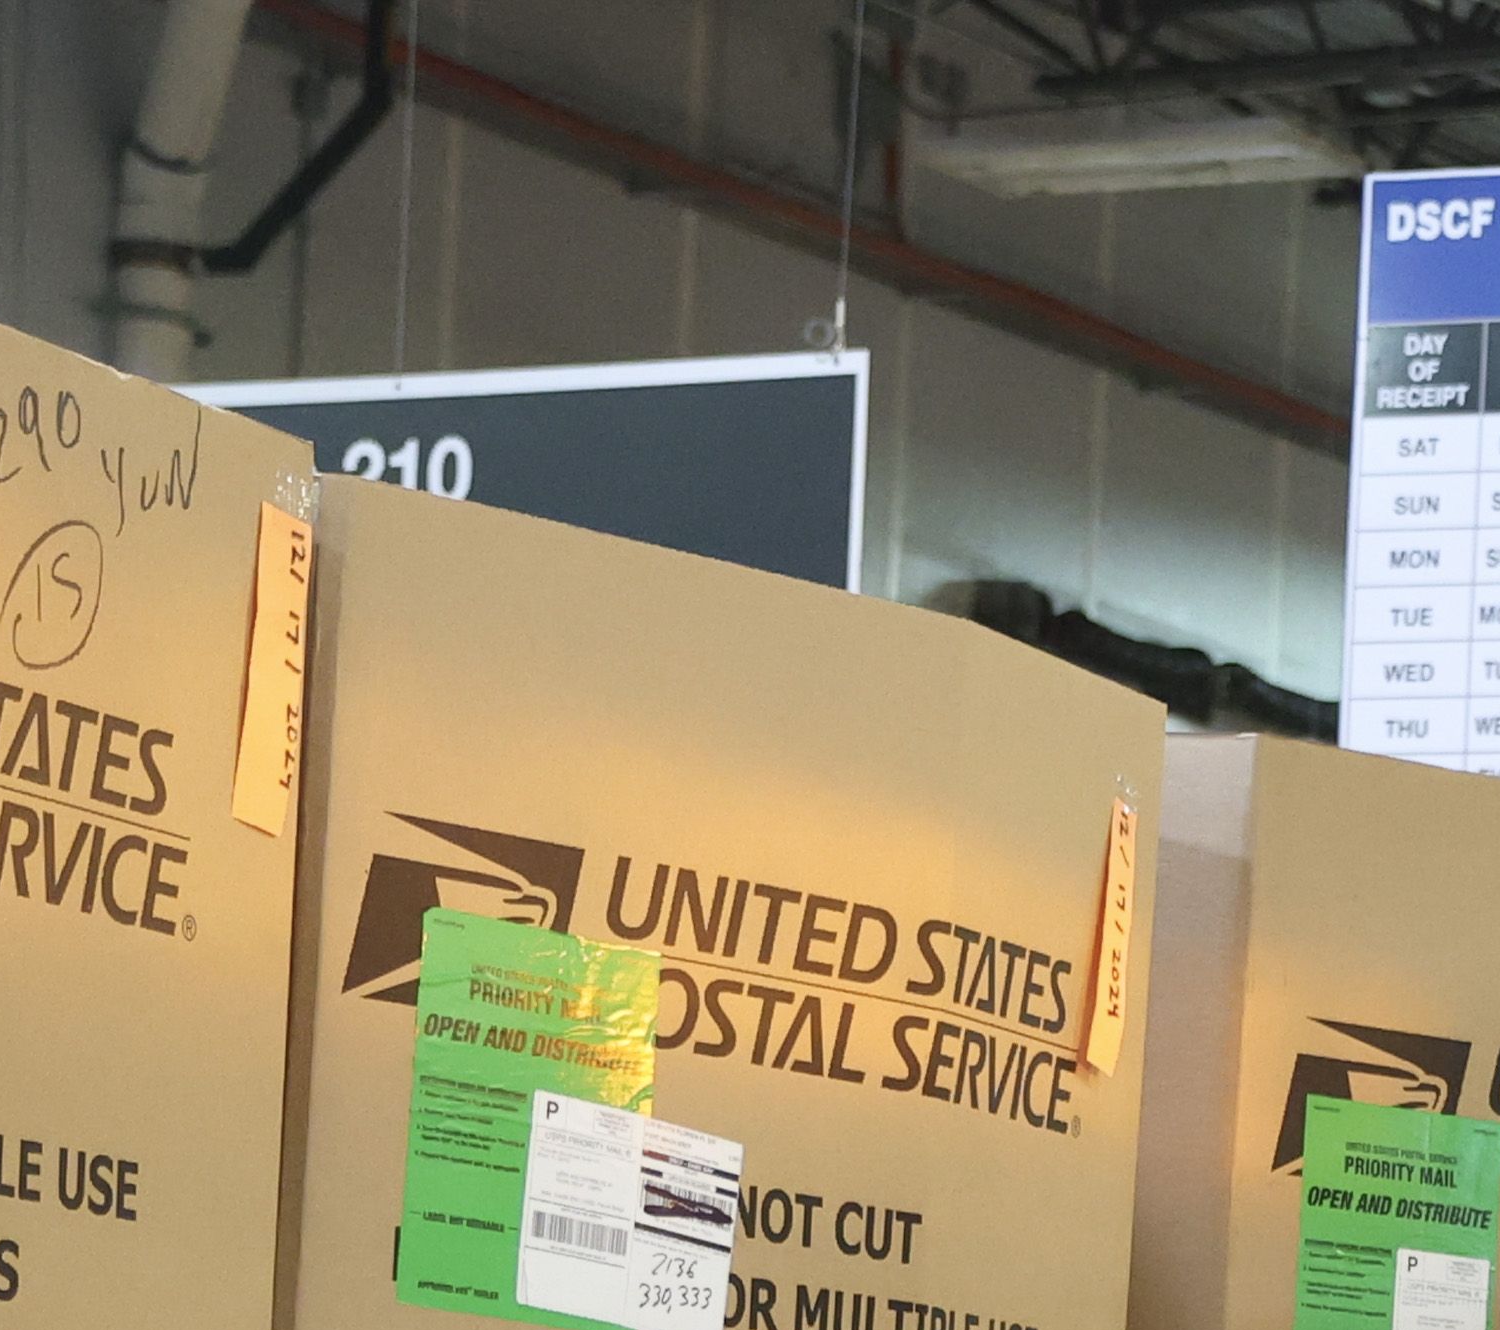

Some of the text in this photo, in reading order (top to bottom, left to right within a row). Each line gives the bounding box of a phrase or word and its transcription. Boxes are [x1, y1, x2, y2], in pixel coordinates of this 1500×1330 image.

[1386, 199, 1495, 242] DSCF
[1403, 332, 1449, 356] DAY
[1408, 359, 1441, 382] OF
[1376, 384, 1470, 409] RECEIPT
[1398, 438, 1440, 458] SAT
[1394, 496, 1440, 516] SUN
[1390, 550, 1440, 569] MON
[1391, 608, 1433, 627] TUE
[1384, 664, 1435, 683] WED
[1386, 719, 1429, 739] THU
[607, 856, 1072, 1036] UNITED STATES
[1344, 1156, 1457, 1189] PRIORITY MAIL
[56, 1147, 141, 1222] USE
[1308, 1186, 1492, 1230] OPEN AND DISTRIBUTE
